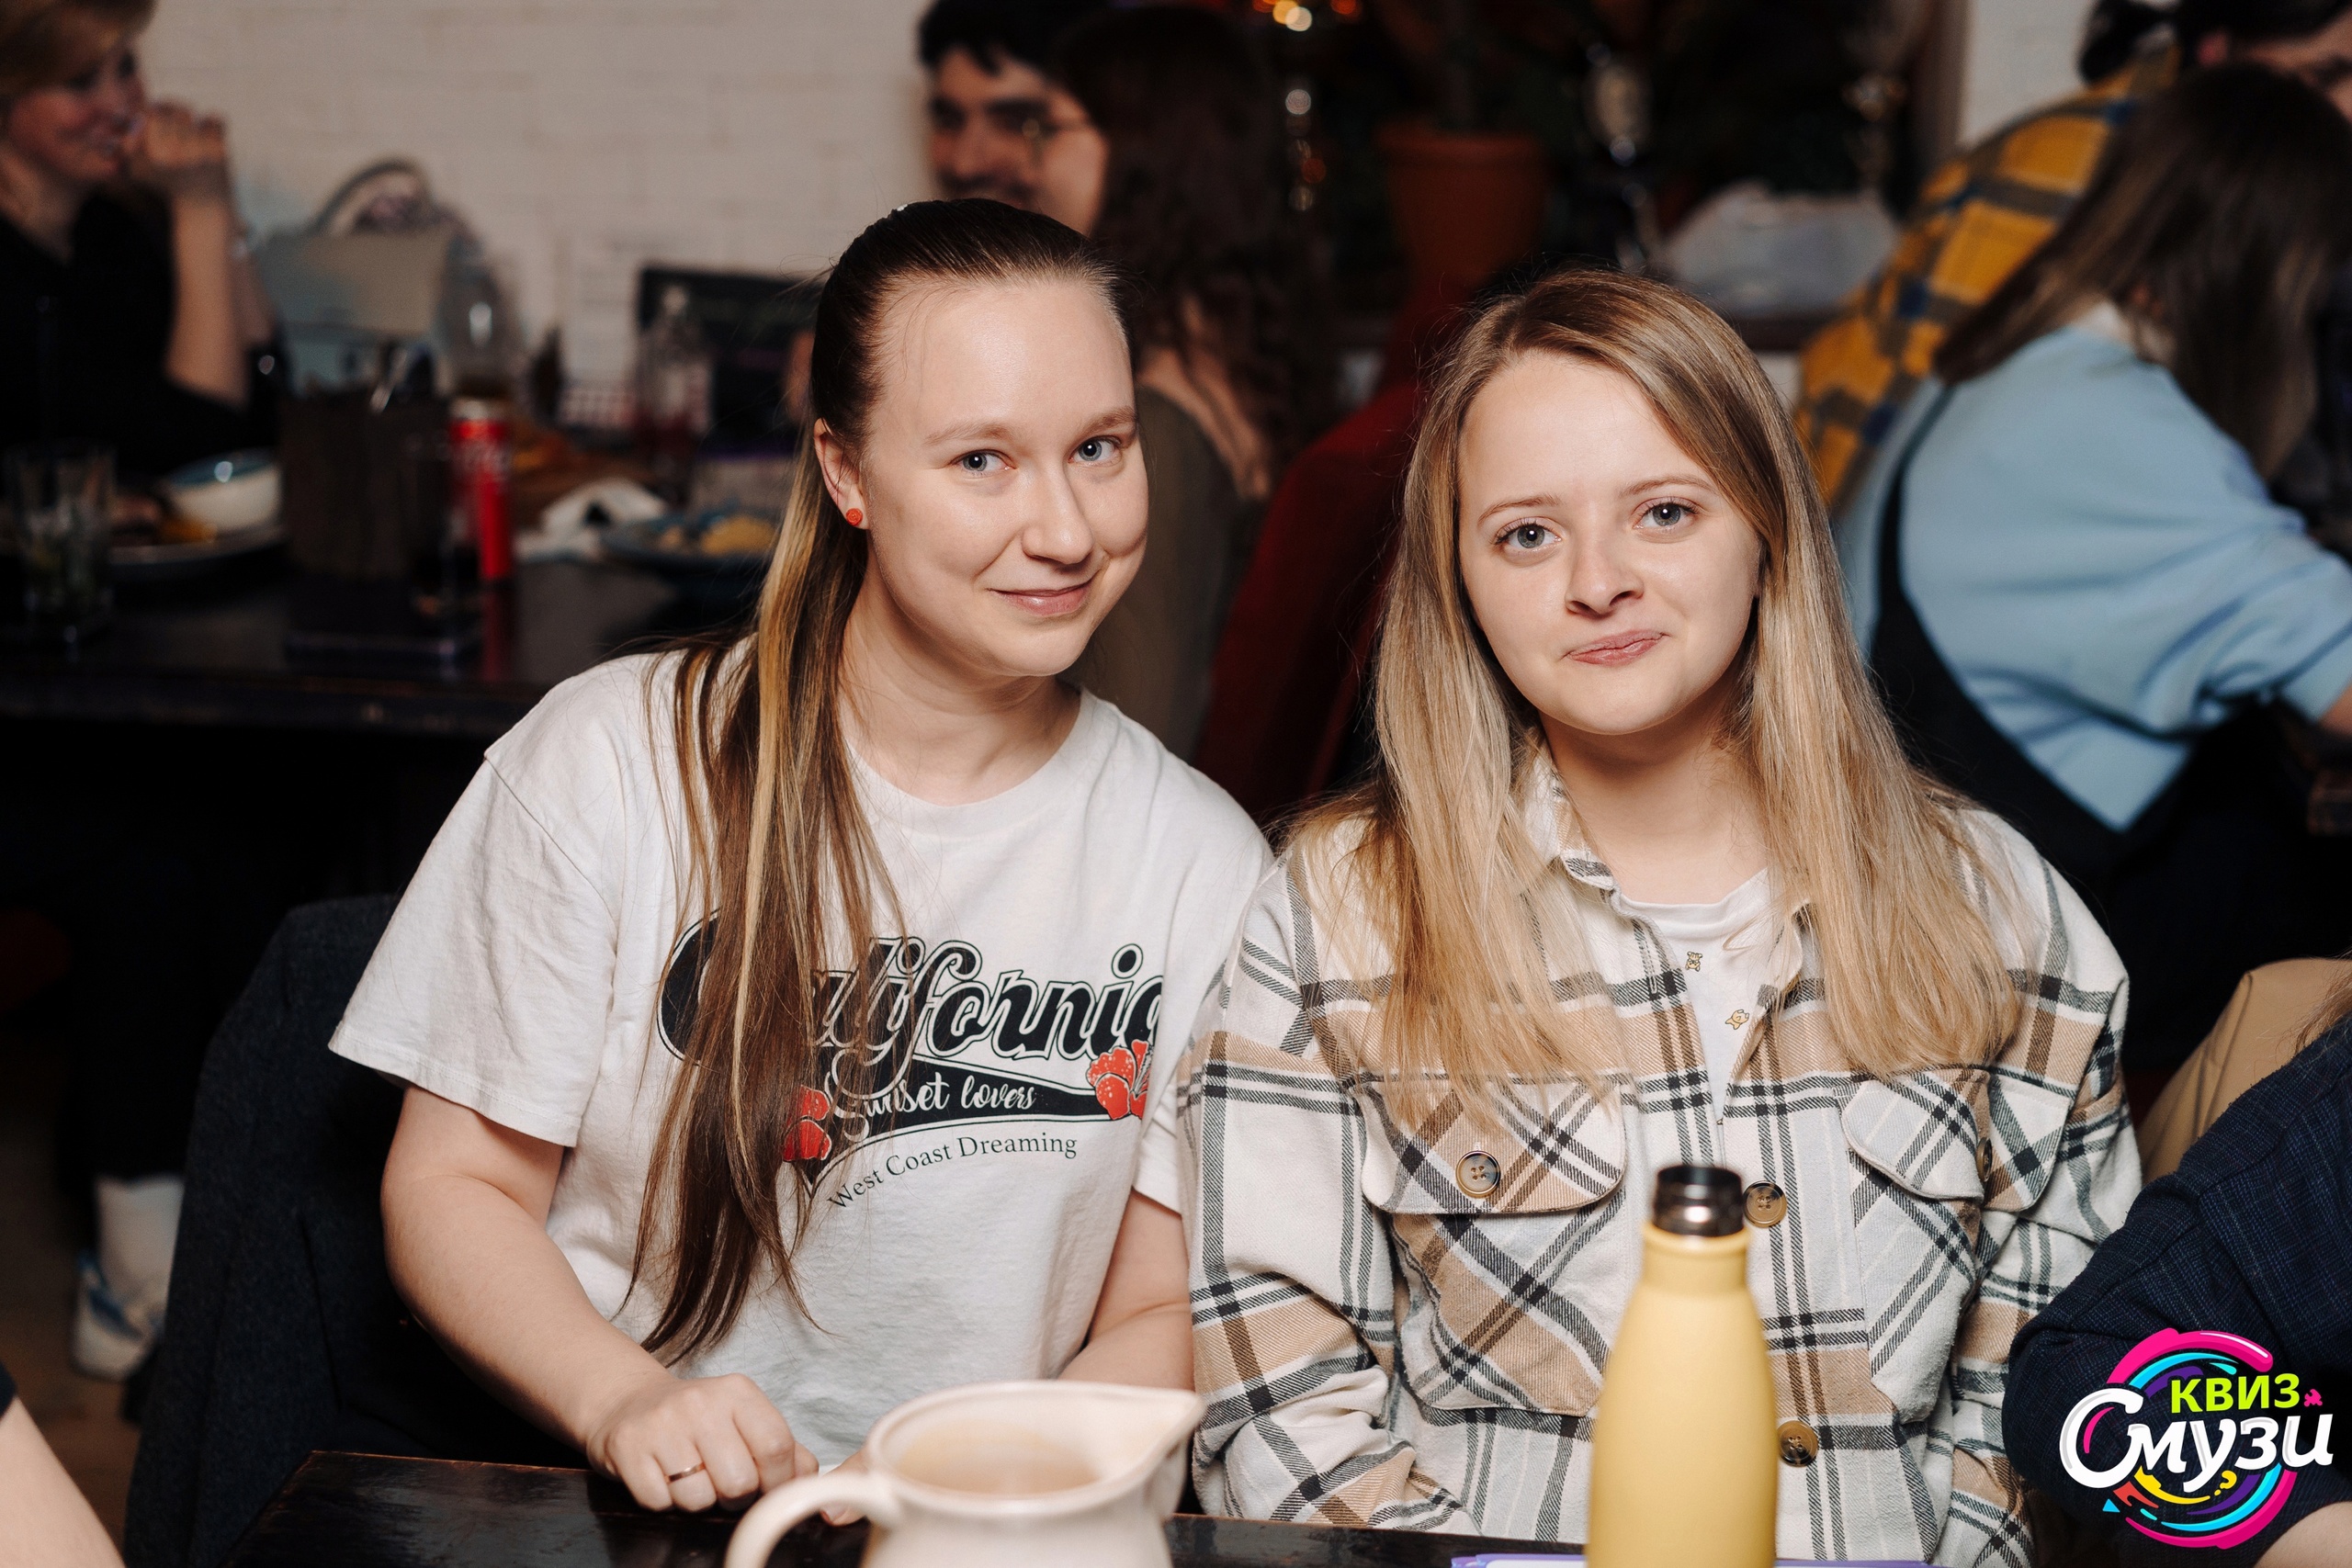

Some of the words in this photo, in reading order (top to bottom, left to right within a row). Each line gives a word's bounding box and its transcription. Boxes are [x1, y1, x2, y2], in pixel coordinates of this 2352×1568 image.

[825, 1071, 950, 1142] Sunset
[960, 1075, 1036, 1110] lovers
[828, 1168, 885, 1210] West
[886, 1145, 954, 1177] Coast
[956, 1133, 1079, 1159] Dreaming
